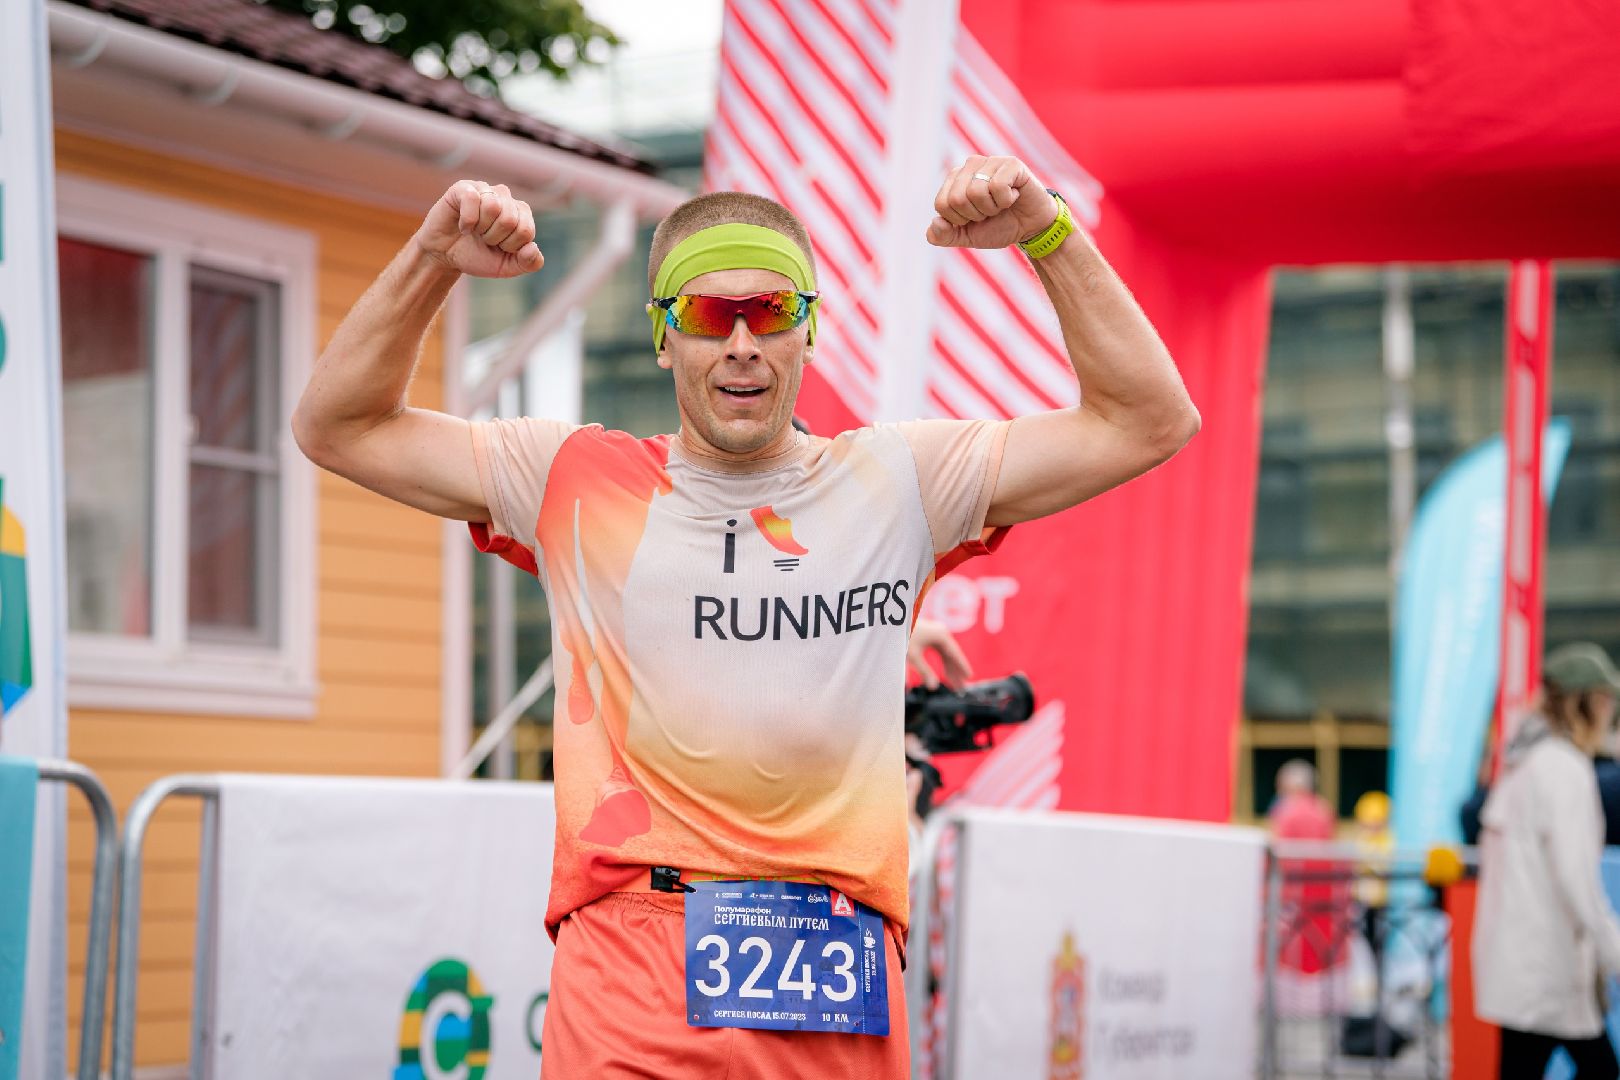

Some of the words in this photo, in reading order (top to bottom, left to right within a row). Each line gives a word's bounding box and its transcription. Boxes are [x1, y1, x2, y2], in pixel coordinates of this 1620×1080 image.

[723, 518, 738, 574] i
[694, 579, 910, 642] RUNNERS
[921, 575, 1020, 634] ет
[714, 905, 771, 915] Полумарафон
[714, 913, 788, 929] СЕРГИЕВЫМ
[788, 917, 830, 931] ПУТЕМ
[694, 934, 858, 1003] 3243
[713, 1009, 746, 1019] СЕРГИЕВ
[747, 1010, 772, 1020] ПОСАД
[772, 1010, 806, 1021] 15.07.2023
[822, 1012, 831, 1021] 10
[834, 1012, 849, 1023] КМ
